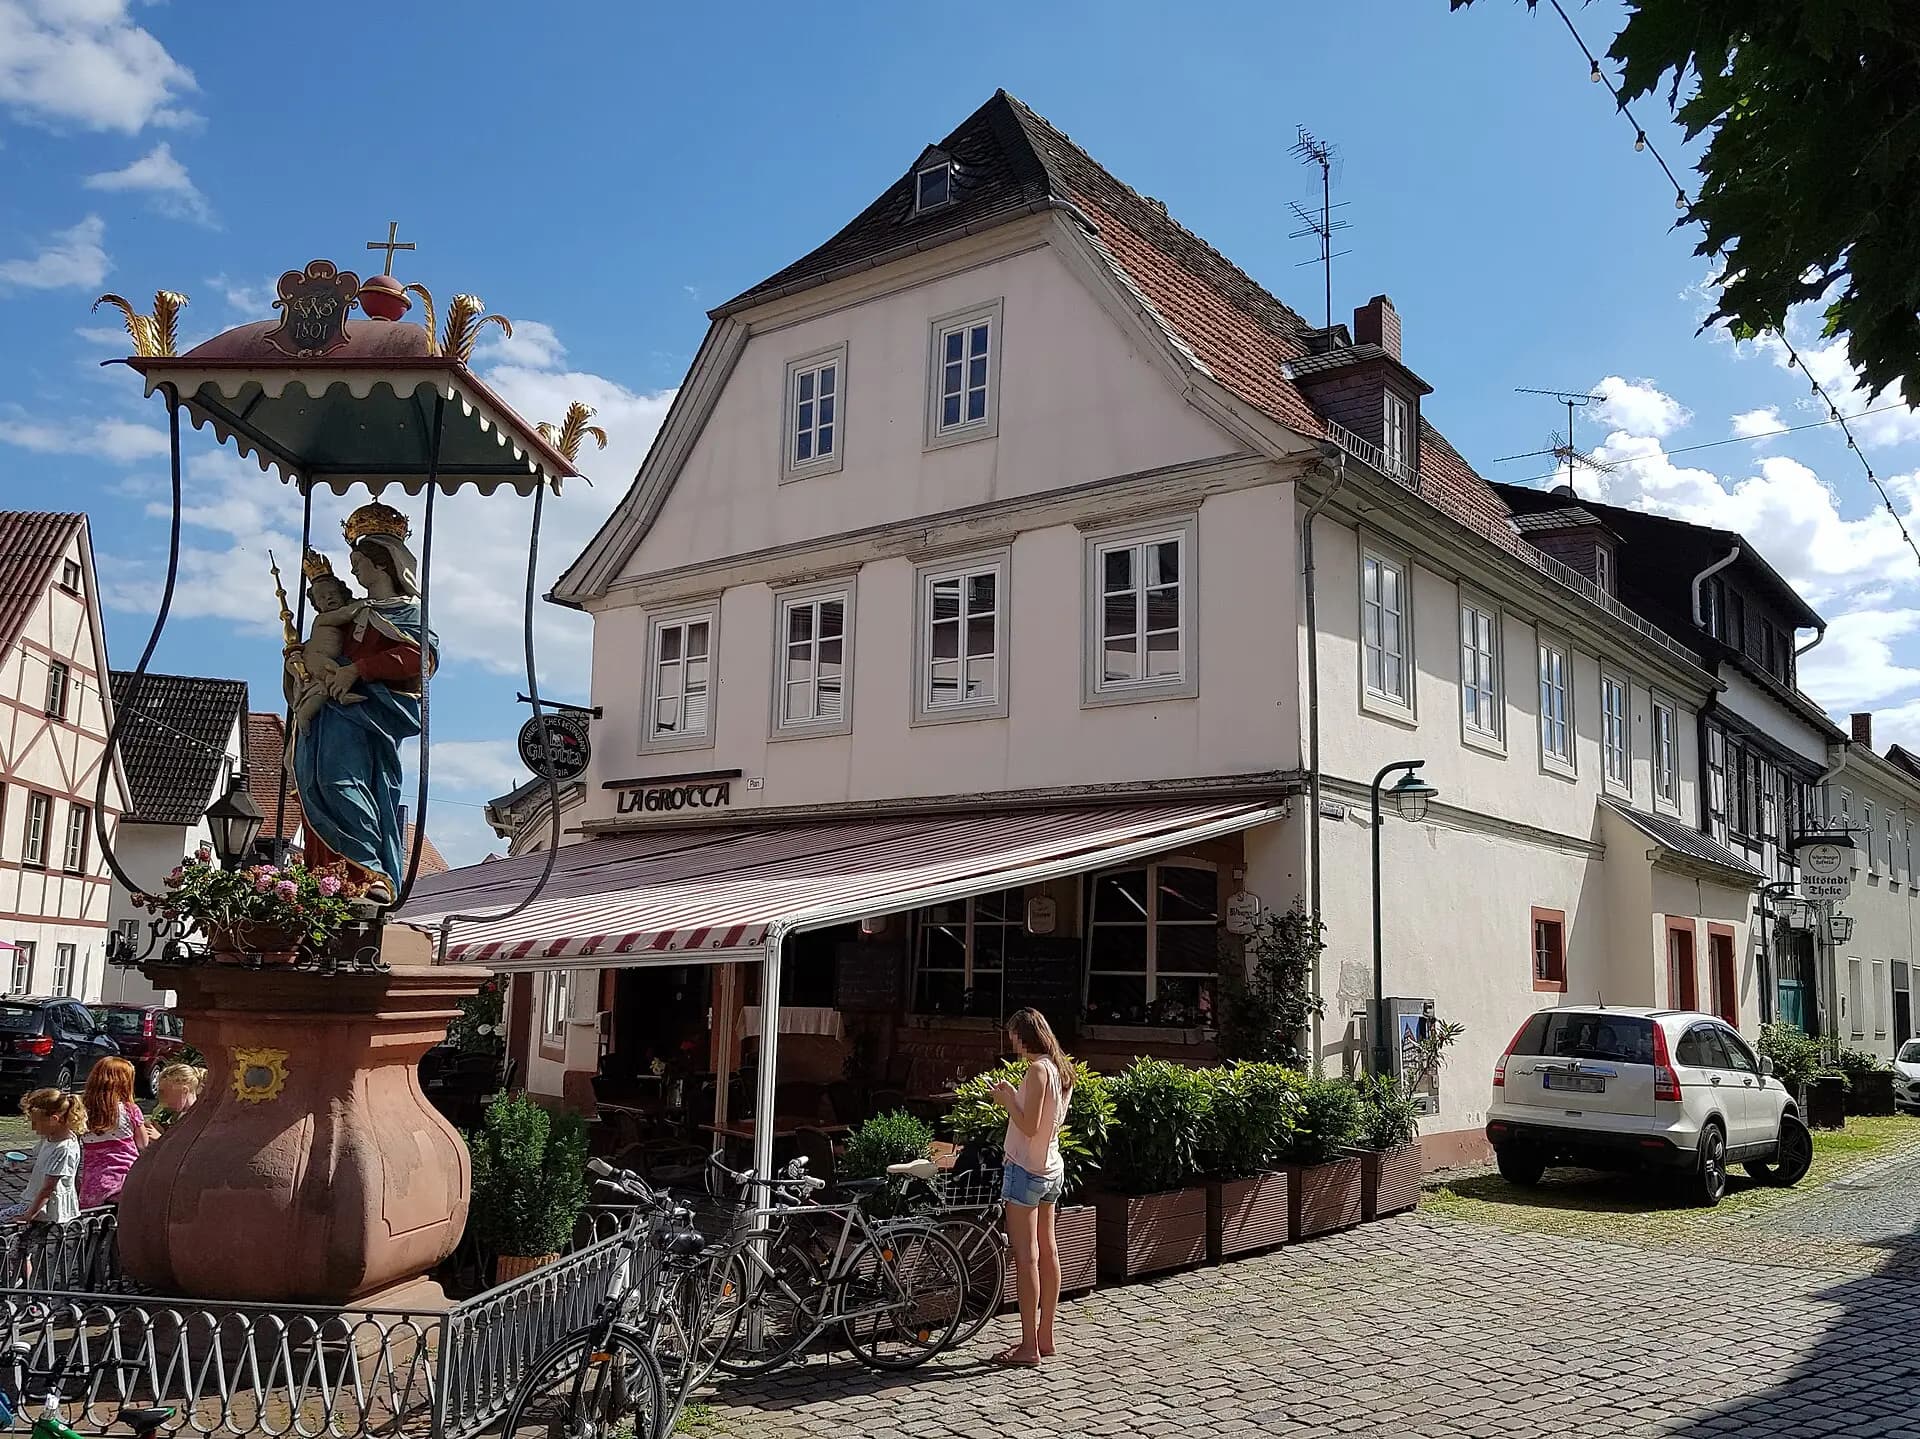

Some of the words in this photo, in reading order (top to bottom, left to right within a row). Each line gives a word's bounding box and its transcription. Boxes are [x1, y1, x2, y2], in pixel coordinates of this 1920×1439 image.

[295, 321, 328, 340] 1801
[524, 717, 561, 744] ITALIECHES
[539, 763, 569, 777] PIZERIA
[1802, 875, 1848, 885] Altstadt
[1808, 885, 1842, 897] Theke
